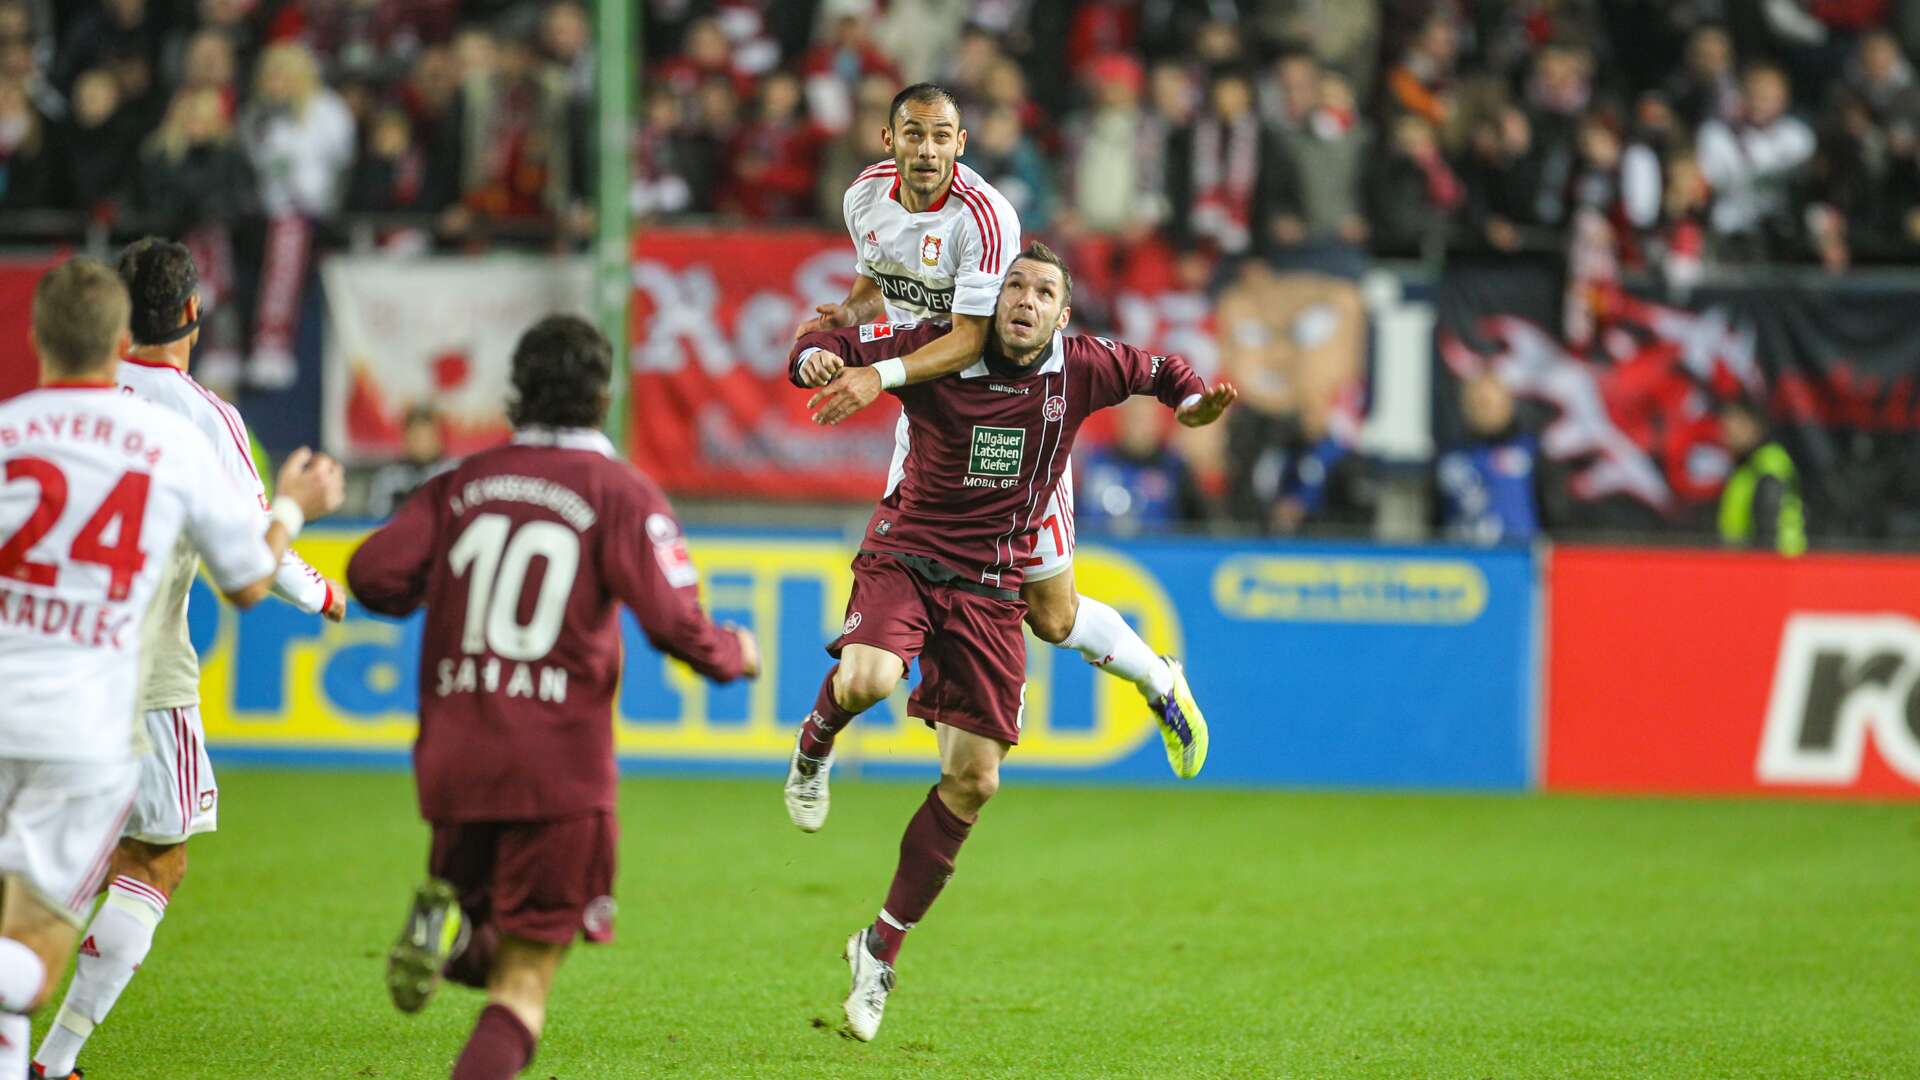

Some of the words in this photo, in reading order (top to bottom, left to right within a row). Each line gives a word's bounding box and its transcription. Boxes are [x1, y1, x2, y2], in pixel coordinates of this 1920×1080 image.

[989, 383, 1030, 395] uhlsport
[0, 412, 114, 446] BAYER
[976, 431, 1021, 447] Allgäuer
[974, 444, 1019, 459] Latschen
[963, 476, 998, 489] MOBIL
[0, 455, 152, 602] 24
[448, 512, 580, 662] 10
